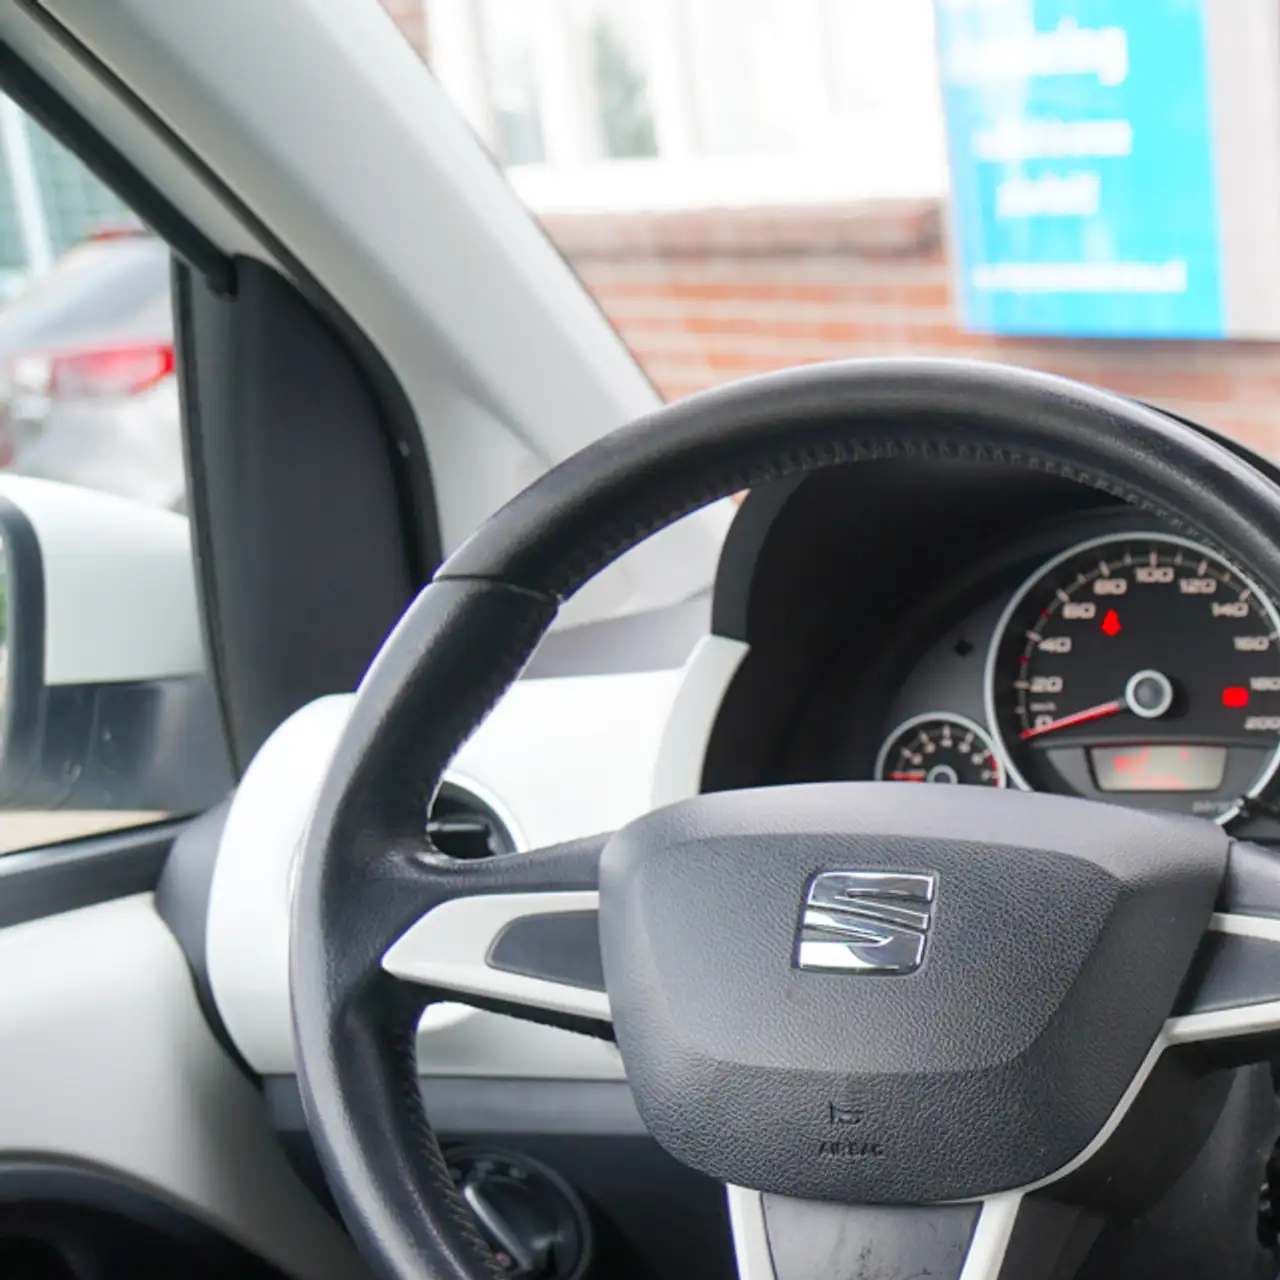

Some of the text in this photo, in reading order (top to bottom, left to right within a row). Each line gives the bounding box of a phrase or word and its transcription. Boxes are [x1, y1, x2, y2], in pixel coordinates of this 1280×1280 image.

[1135, 567, 1174, 583] 100
[1179, 578, 1217, 594] 120
[1212, 602, 1249, 617] 140
[1038, 636, 1072, 653] 40
[1031, 676, 1063, 693] 20
